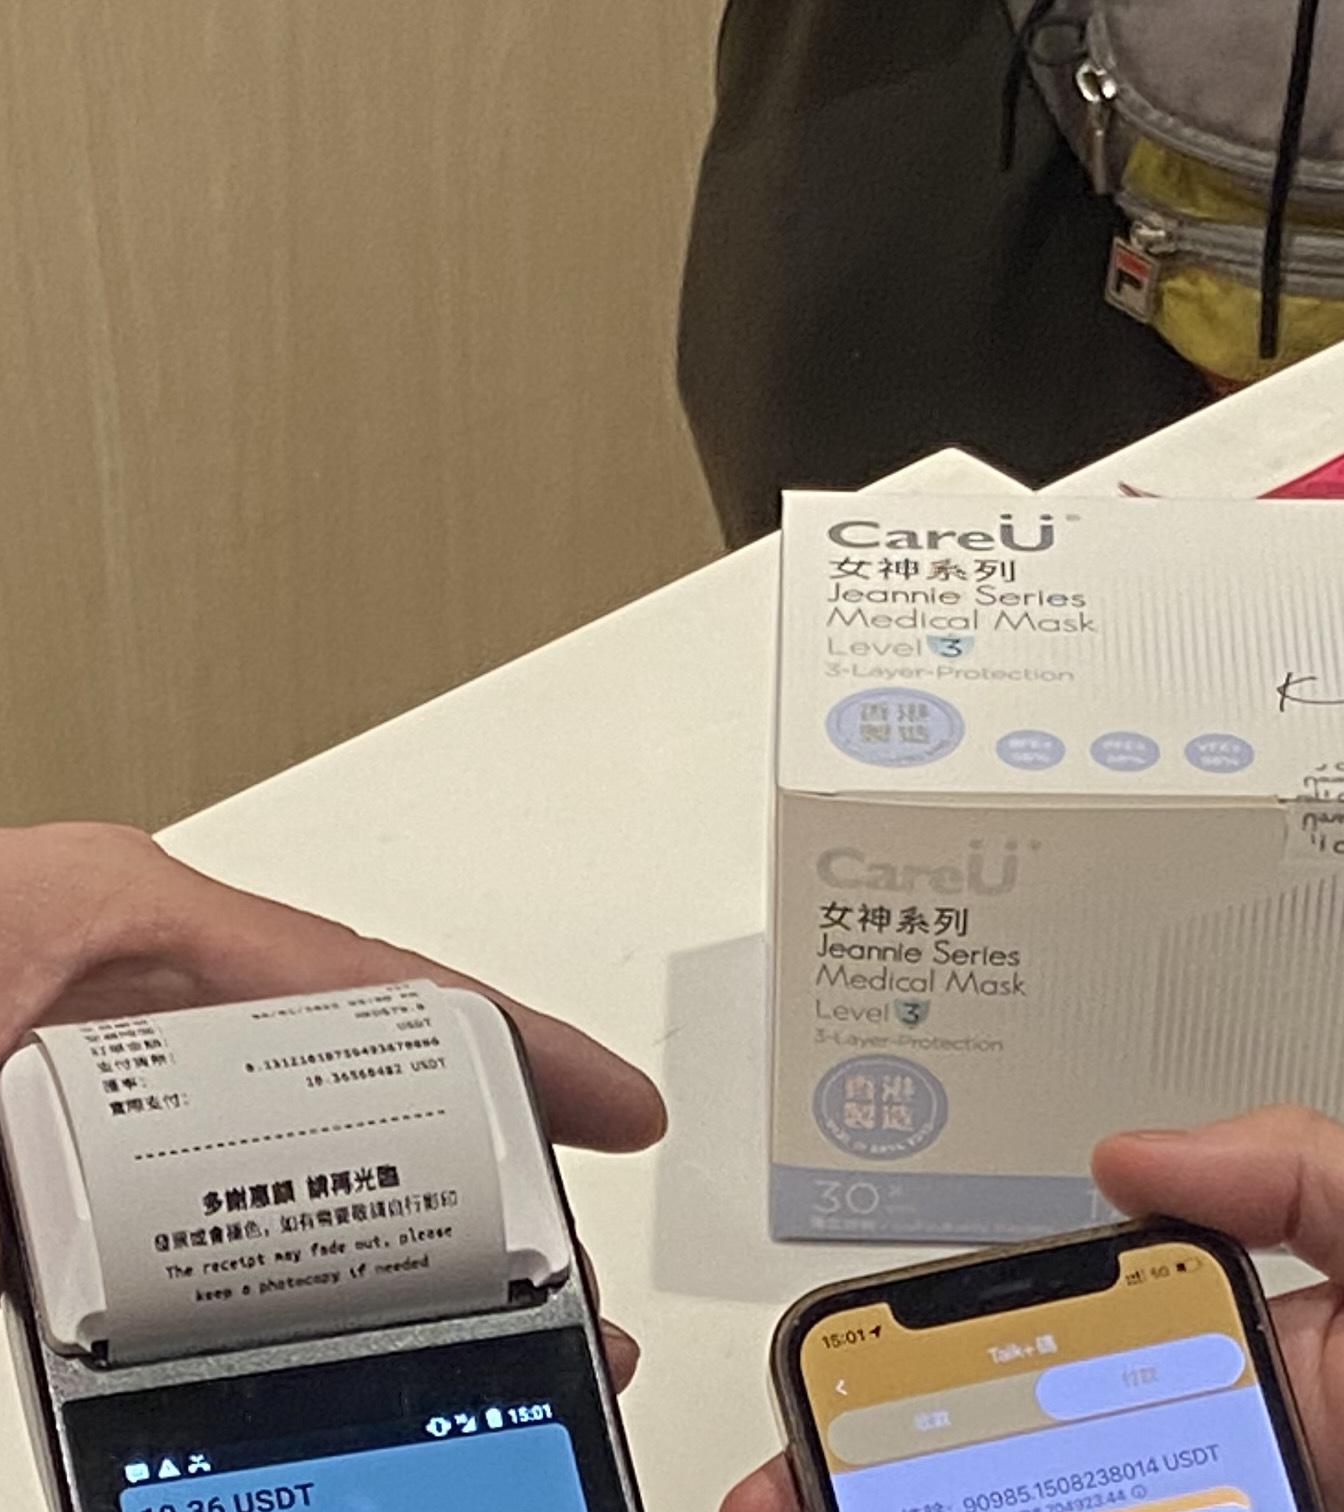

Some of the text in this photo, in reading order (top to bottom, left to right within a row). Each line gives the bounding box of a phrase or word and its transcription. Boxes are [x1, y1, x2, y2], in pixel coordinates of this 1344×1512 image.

[828, 557, 1017, 583] 女神系列
[827, 584, 1087, 609] Jeannie Series
[826, 608, 1096, 634] Medical Mask
[827, 638, 965, 658] Level 3
[819, 901, 970, 937] 女神系列
[817, 934, 1021, 967] Jeannie Series
[816, 964, 1027, 998] Medical Mask
[816, 1000, 921, 1026] Level 3
[411, 1056, 447, 1073] USDT
[814, 1180, 880, 1214] 30
[165, 1265, 194, 1280] The
[203, 1252, 266, 1275] receipt
[275, 1248, 302, 1264] may
[311, 1239, 346, 1259] fade
[399, 1225, 453, 1246] please
[196, 1288, 234, 1304] keep
[259, 1271, 341, 1295] photocopy
[349, 1263, 367, 1280] if
[375, 1254, 430, 1275] needed
[822, 1328, 867, 1349] 15:01
[507, 1403, 554, 1425] 15:01
[1164, 1444, 1220, 1471] USDT
